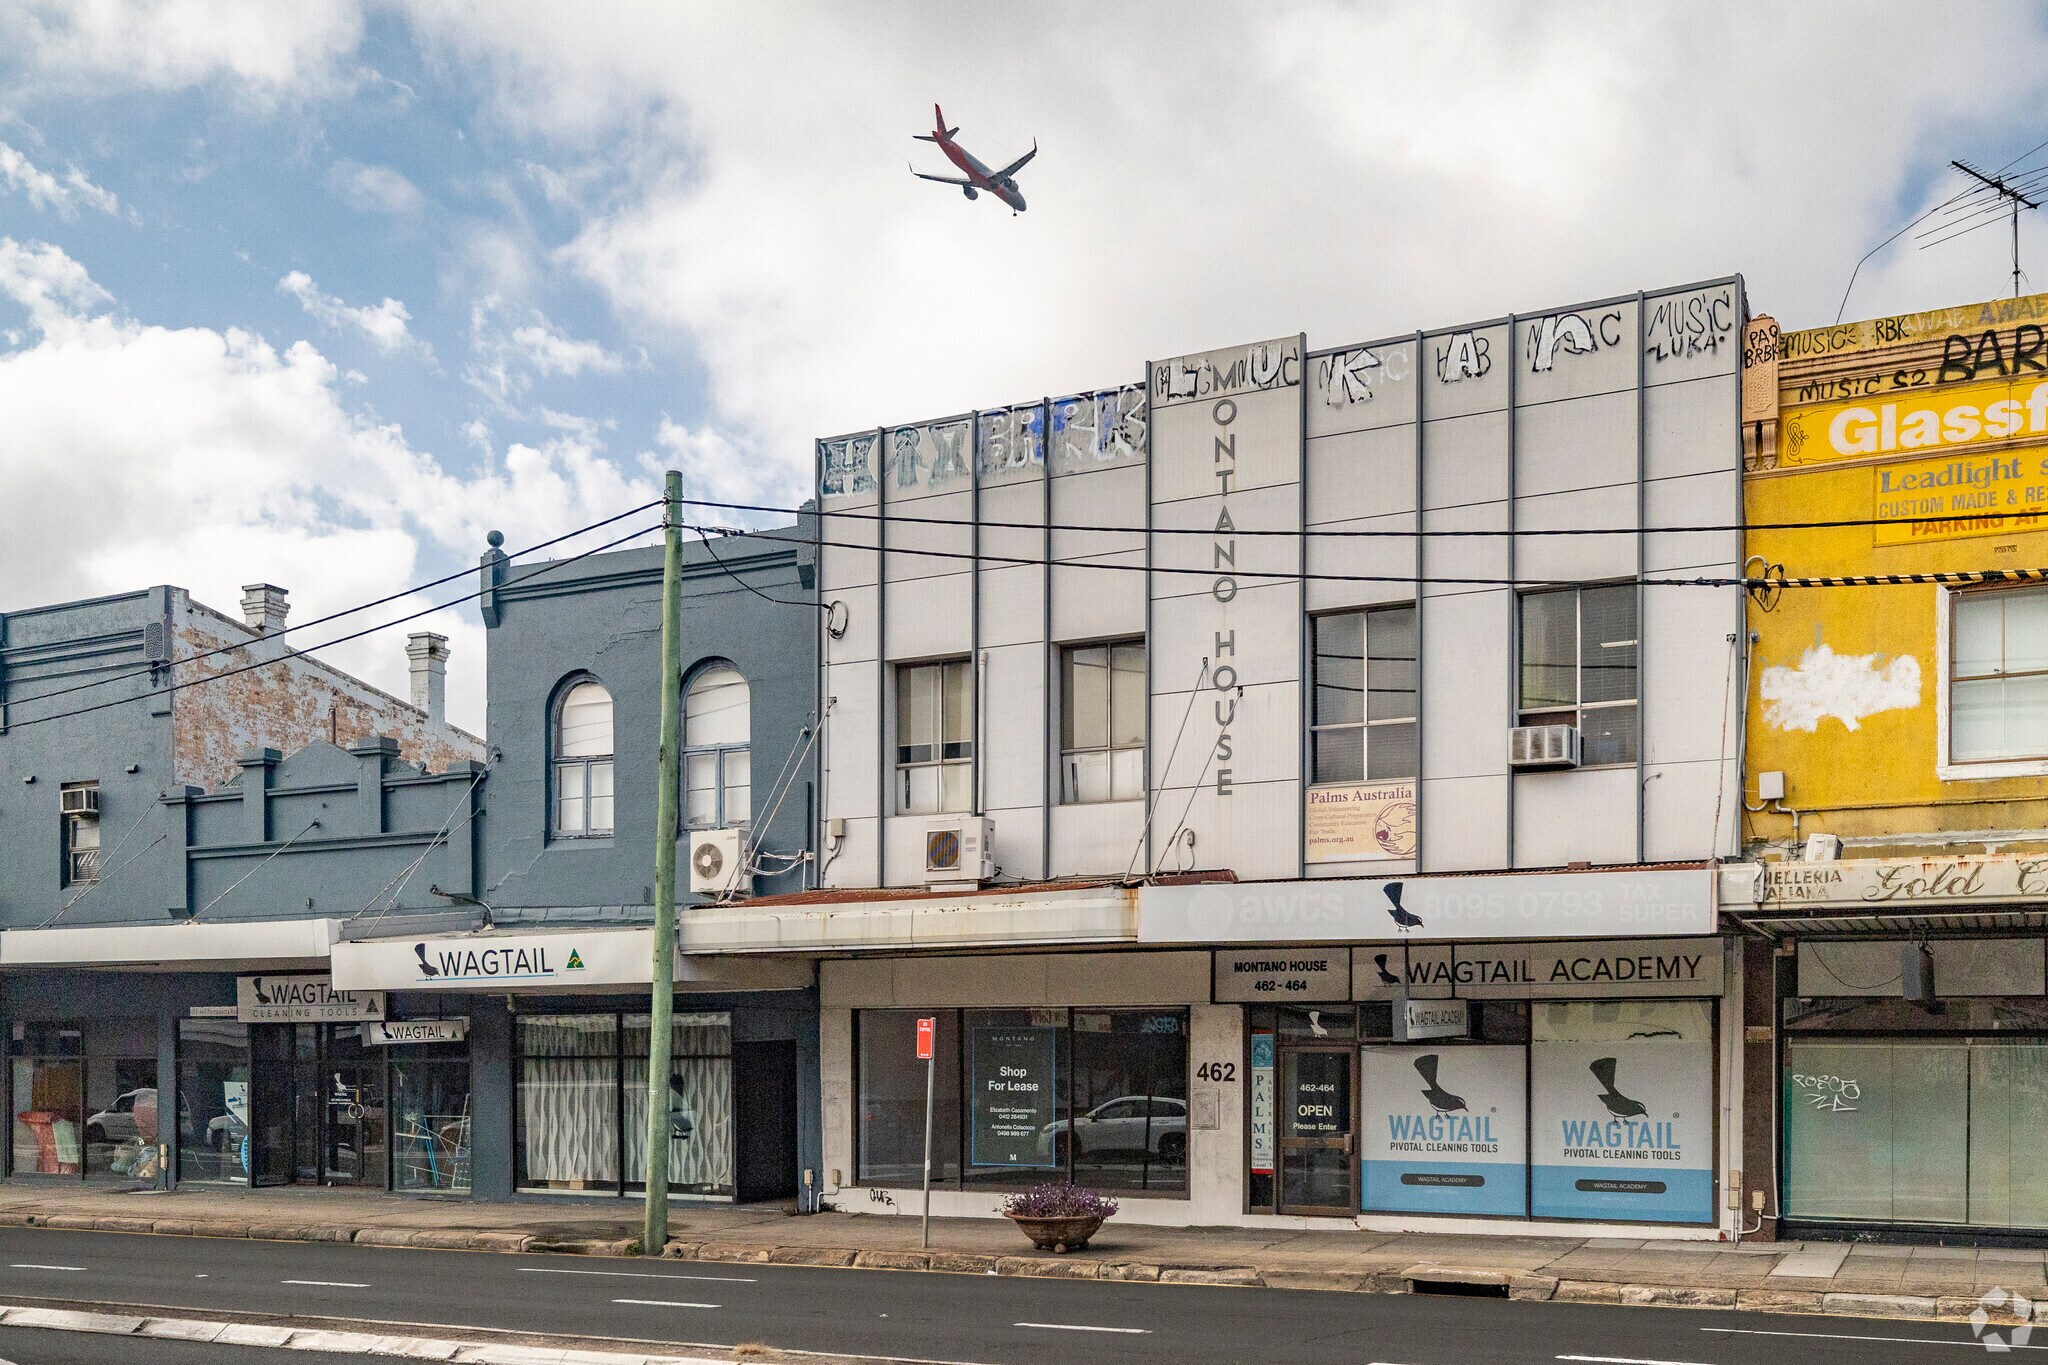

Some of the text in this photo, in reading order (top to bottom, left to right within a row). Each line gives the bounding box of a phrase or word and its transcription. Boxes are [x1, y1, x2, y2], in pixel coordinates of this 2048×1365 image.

[1879, 457, 2023, 494] Leadlight
[1879, 485, 2048, 518] CUSTOM MADE & RE
[1911, 510, 2004, 536] PARKING
[1213, 360, 1237, 796] MONTANO HOUSE
[1310, 787, 1412, 804] Palms Australia
[1309, 837, 1354, 845] palms.org.au
[439, 947, 554, 976] WAGTAIL
[1234, 960, 1327, 973] MONTANO HOUSE
[1407, 955, 1702, 984] WAGTAIL ACADEMY
[271, 983, 357, 1004] WAGTAIL
[253, 1006, 358, 1018] CLEANING TOOLS
[1415, 1011, 1439, 1026] WAGTAIL
[392, 1025, 445, 1040] WAGTAIL
[1000, 1066, 1027, 1078] Shop
[1197, 1062, 1235, 1082] 462
[988, 1080, 1039, 1091] For Lease
[1300, 1084, 1335, 1092] 462-464
[1253, 1075, 1265, 1149] PALMS
[1298, 1105, 1333, 1116] OPEN
[1293, 1123, 1338, 1131] Please Enter
[1388, 1115, 1498, 1142] WAGTAIL
[1562, 1120, 1681, 1149] WAGTAIL
[1390, 1142, 1498, 1153] PIVOTAL CLEANING TOOLS
[1564, 1149, 1681, 1160] PIVOTAL CLEANING TOOLS
